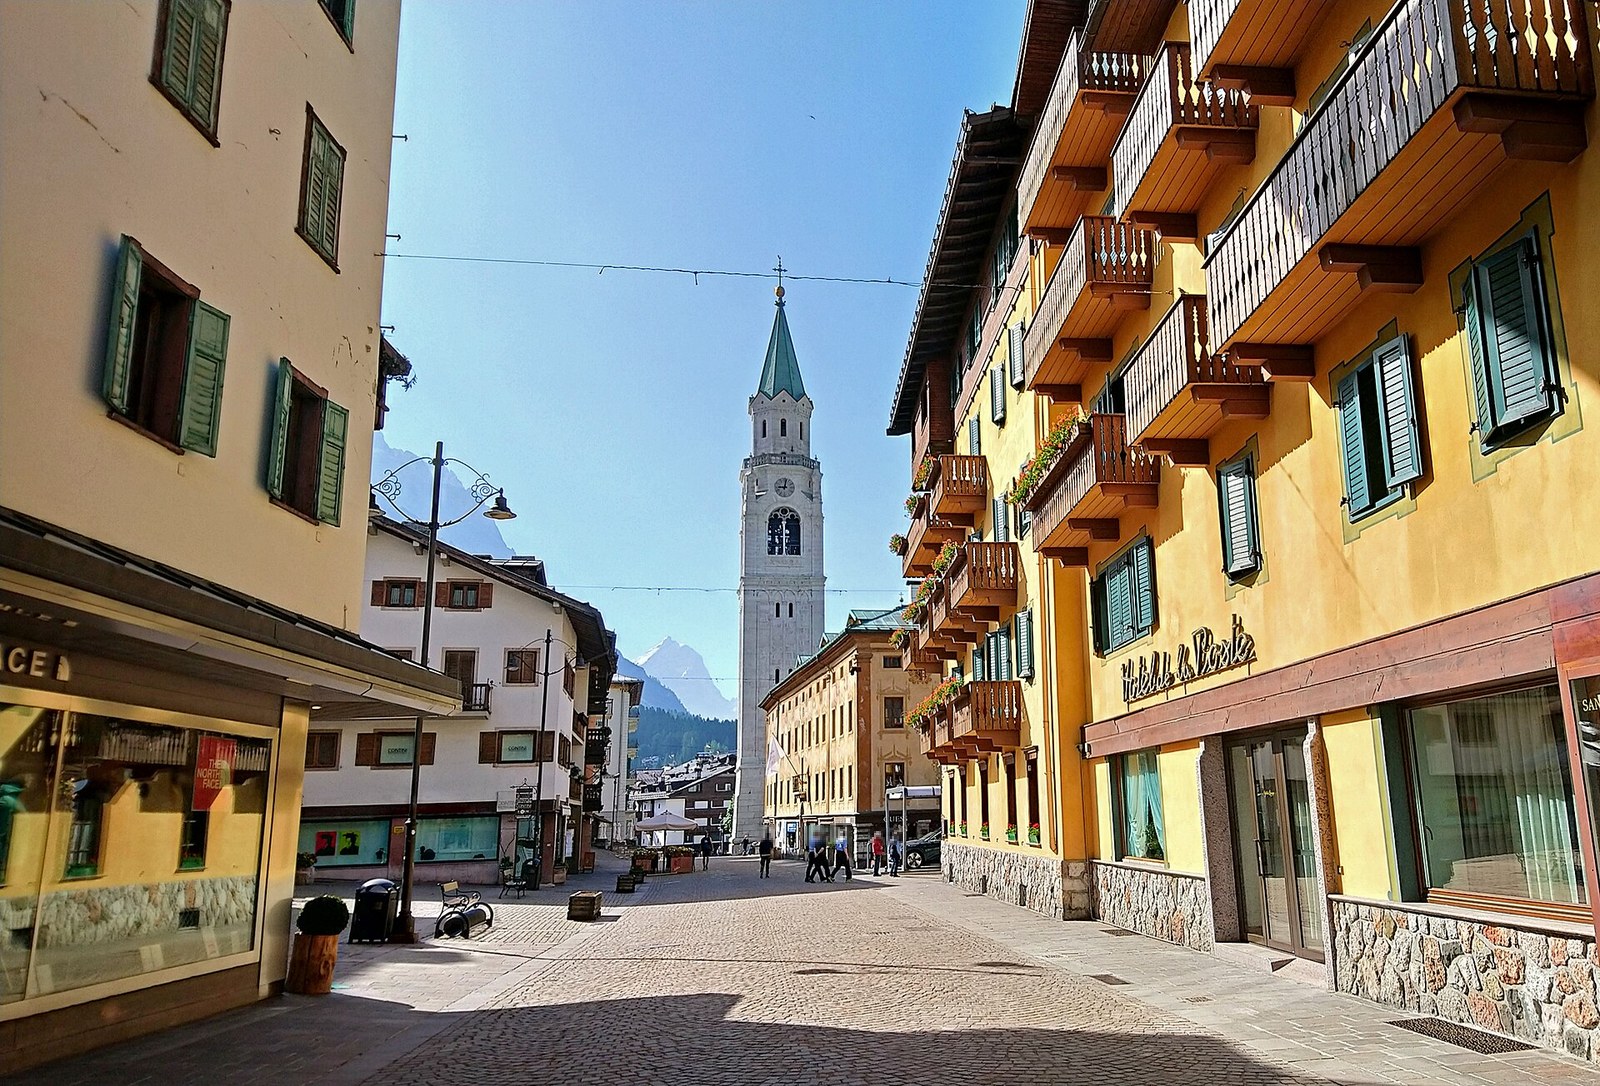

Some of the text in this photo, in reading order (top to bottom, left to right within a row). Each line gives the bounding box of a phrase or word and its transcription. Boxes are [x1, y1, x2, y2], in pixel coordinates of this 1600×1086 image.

[1192, 613, 1256, 676] Poste
[0, 645, 46, 677] CE
[208, 759, 221, 768] THE
[197, 768, 220, 778] NORTH
[202, 779, 220, 789] FACE
